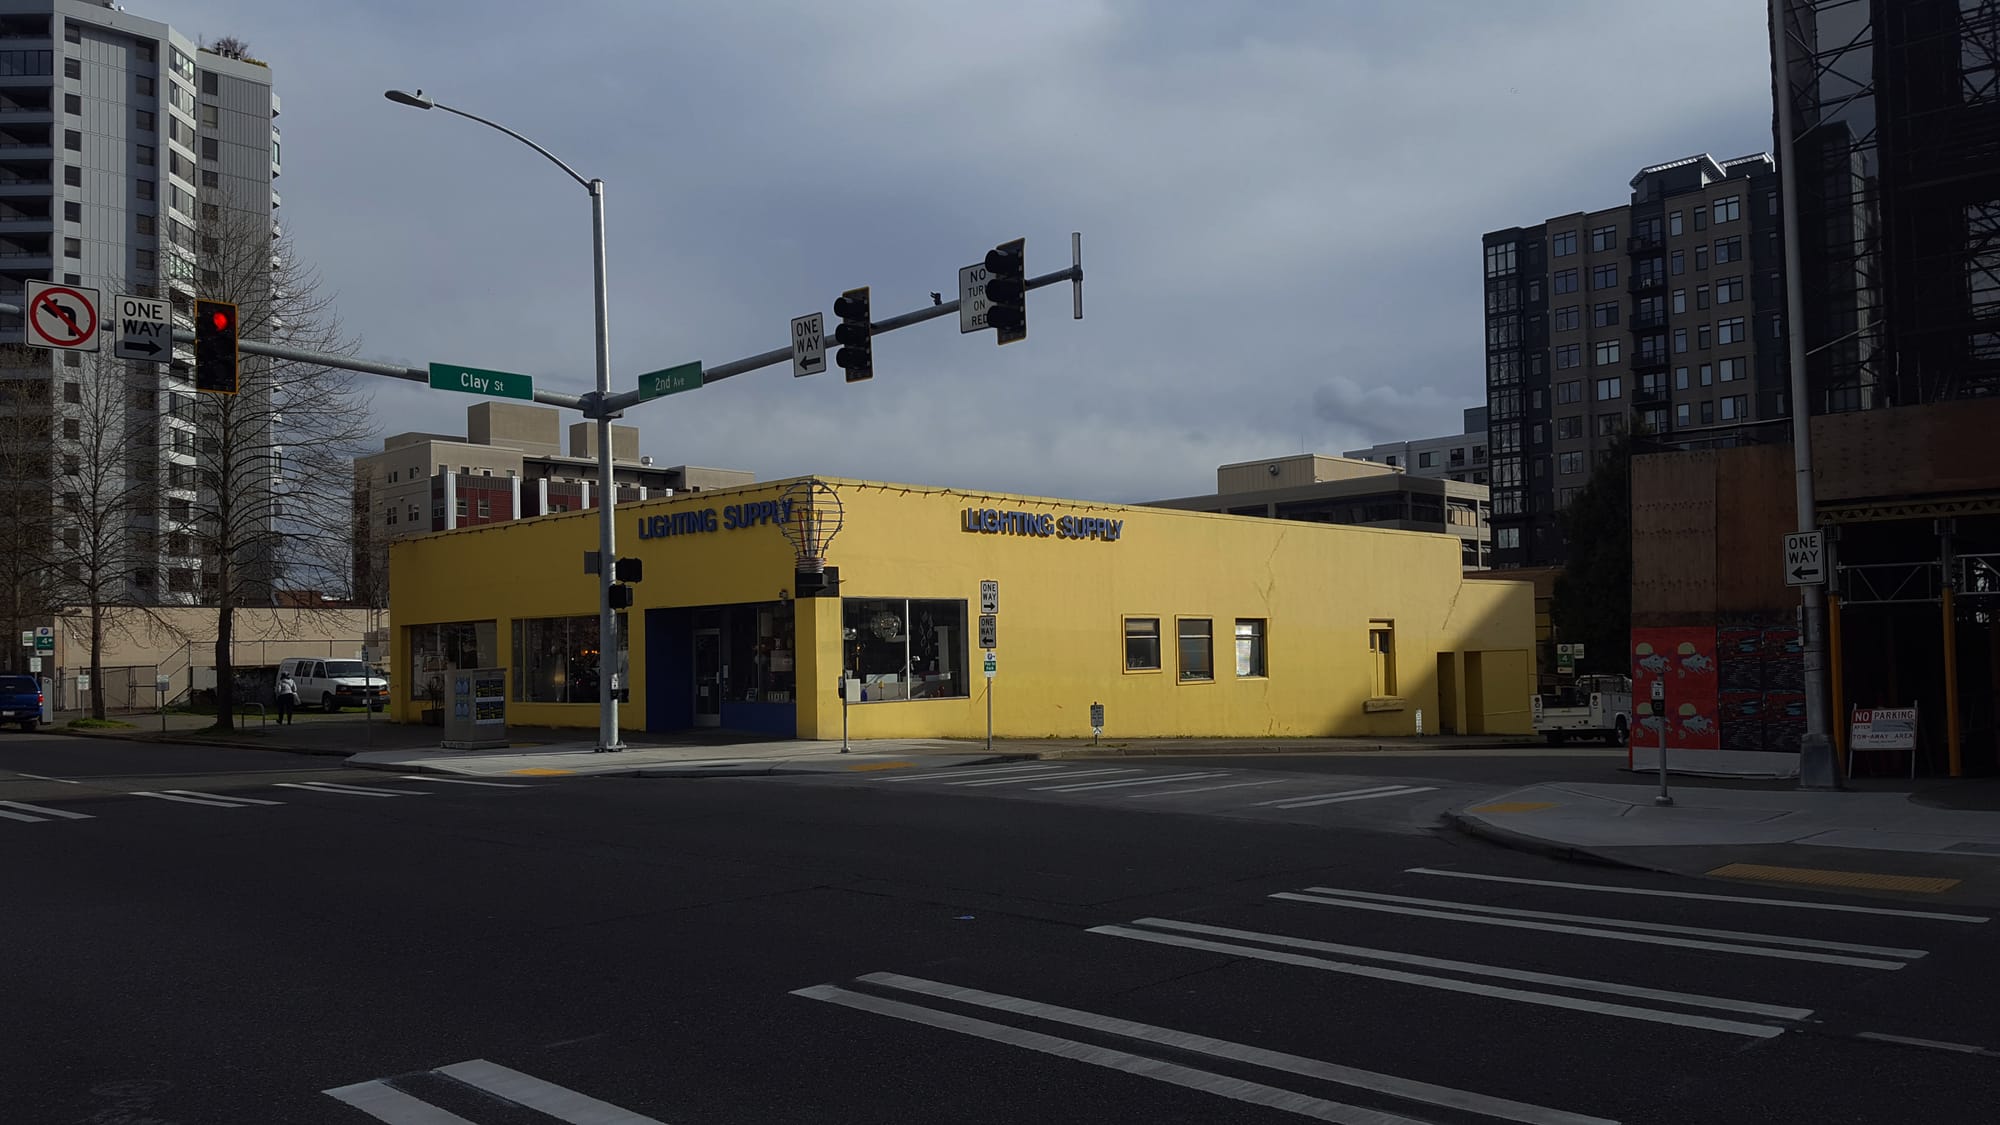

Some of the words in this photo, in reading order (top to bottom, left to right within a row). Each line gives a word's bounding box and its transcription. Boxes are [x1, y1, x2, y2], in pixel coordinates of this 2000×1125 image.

[970, 268, 986, 283] NO
[968, 285, 988, 298] TUR
[124, 301, 163, 320] ONE
[973, 299, 986, 312] ON
[122, 318, 164, 337] WAY
[796, 318, 819, 337] ONE
[796, 335, 820, 354] WAY
[460, 372, 490, 393] Clay
[494, 380, 504, 392] St
[655, 375, 671, 391] 2nd
[673, 377, 685, 389] Ave
[638, 508, 718, 540] LIGHTING
[723, 498, 793, 530] SUPPLY
[966, 507, 1055, 537] LIGHTING
[1062, 514, 1124, 540] SUPPLY
[1788, 535, 1818, 550] ONE
[1788, 550, 1819, 564] WAY
[982, 583, 996, 592] ONE
[982, 593, 996, 601] WAY
[981, 618, 994, 626] ONE
[981, 627, 994, 636] WAY
[1855, 711, 1870, 722] NO
[1874, 710, 1913, 720] PARKING
